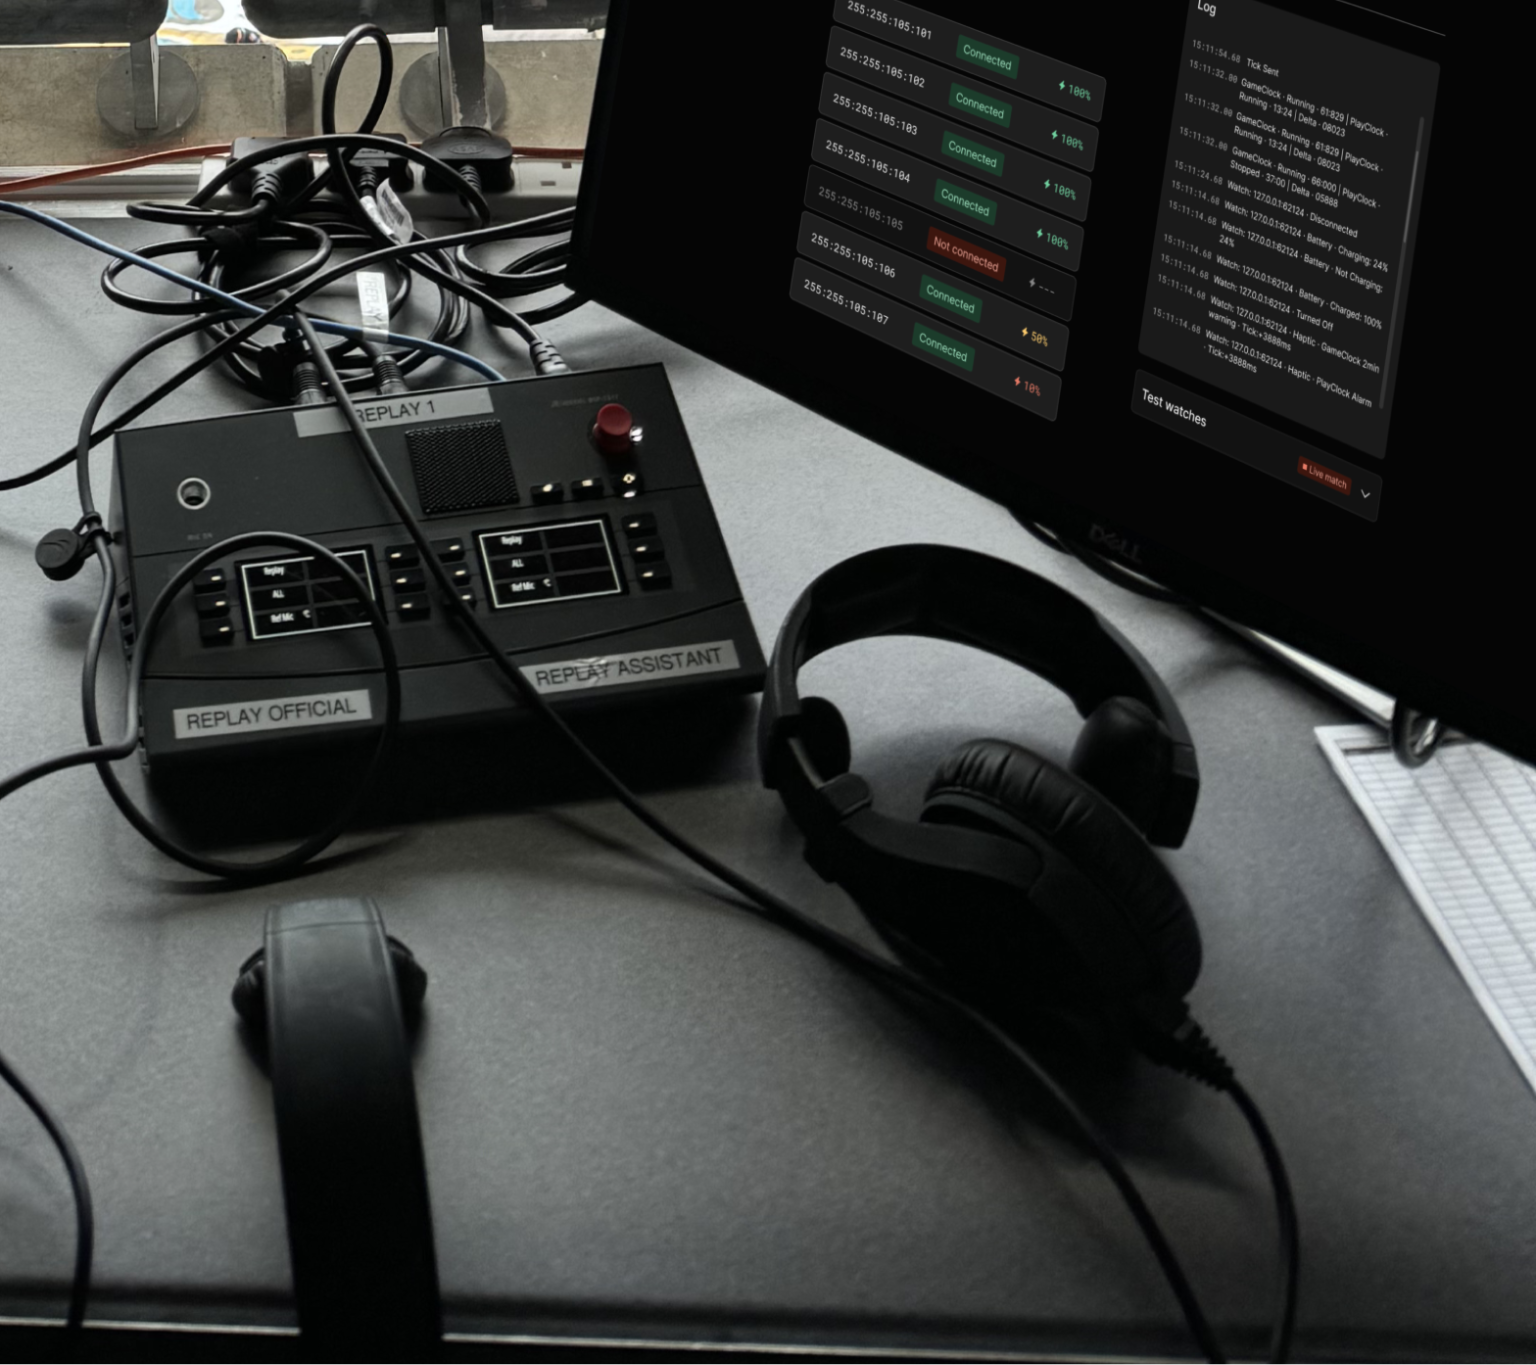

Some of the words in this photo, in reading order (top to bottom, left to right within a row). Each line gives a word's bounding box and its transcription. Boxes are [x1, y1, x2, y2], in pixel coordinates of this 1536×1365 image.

[847, 0, 931, 39] 255:255:105:101
[963, 44, 1012, 70] Connected
[1069, 84, 1091, 101] 100%
[1247, 58, 1261, 70] Tick
[1263, 64, 1279, 77] Sent
[840, 47, 925, 88] 255:255:105:102
[956, 92, 1004, 119] Connected
[1062, 134, 1083, 151] 100%
[833, 93, 917, 135] 255:255:105:103
[948, 140, 997, 168] Connected
[1054, 183, 1076, 200] 100%
[826, 140, 910, 183] 255:255:105:104
[941, 188, 990, 216] Connected
[1047, 233, 1069, 250] 100%
[1228, 180, 1251, 196] Watch:
[1310, 212, 1358, 238] Disconnected
[818, 186, 903, 231] 255:255:105:105
[934, 236, 950, 251] Not
[952, 246, 999, 272] connected
[811, 232, 895, 278] 255:255:105:106
[926, 284, 975, 314] Connected
[1031, 331, 1048, 347] 50%
[804, 279, 889, 325] 255:255:105:107
[919, 332, 968, 362] Connected
[1024, 381, 1041, 397] 10%
[355, 401, 420, 422] REPLAY
[427, 400, 436, 413] 1
[1141, 388, 1164, 408] Test
[1165, 398, 1207, 428] watches
[1308, 463, 1324, 478] Live
[1326, 471, 1348, 490] match
[1088, 522, 1144, 564] DELL
[536, 658, 608, 686] REPLAY
[611, 647, 723, 678] ASSISTANT
[186, 705, 263, 731] REPLAY
[268, 697, 357, 723] OFFICIAL
